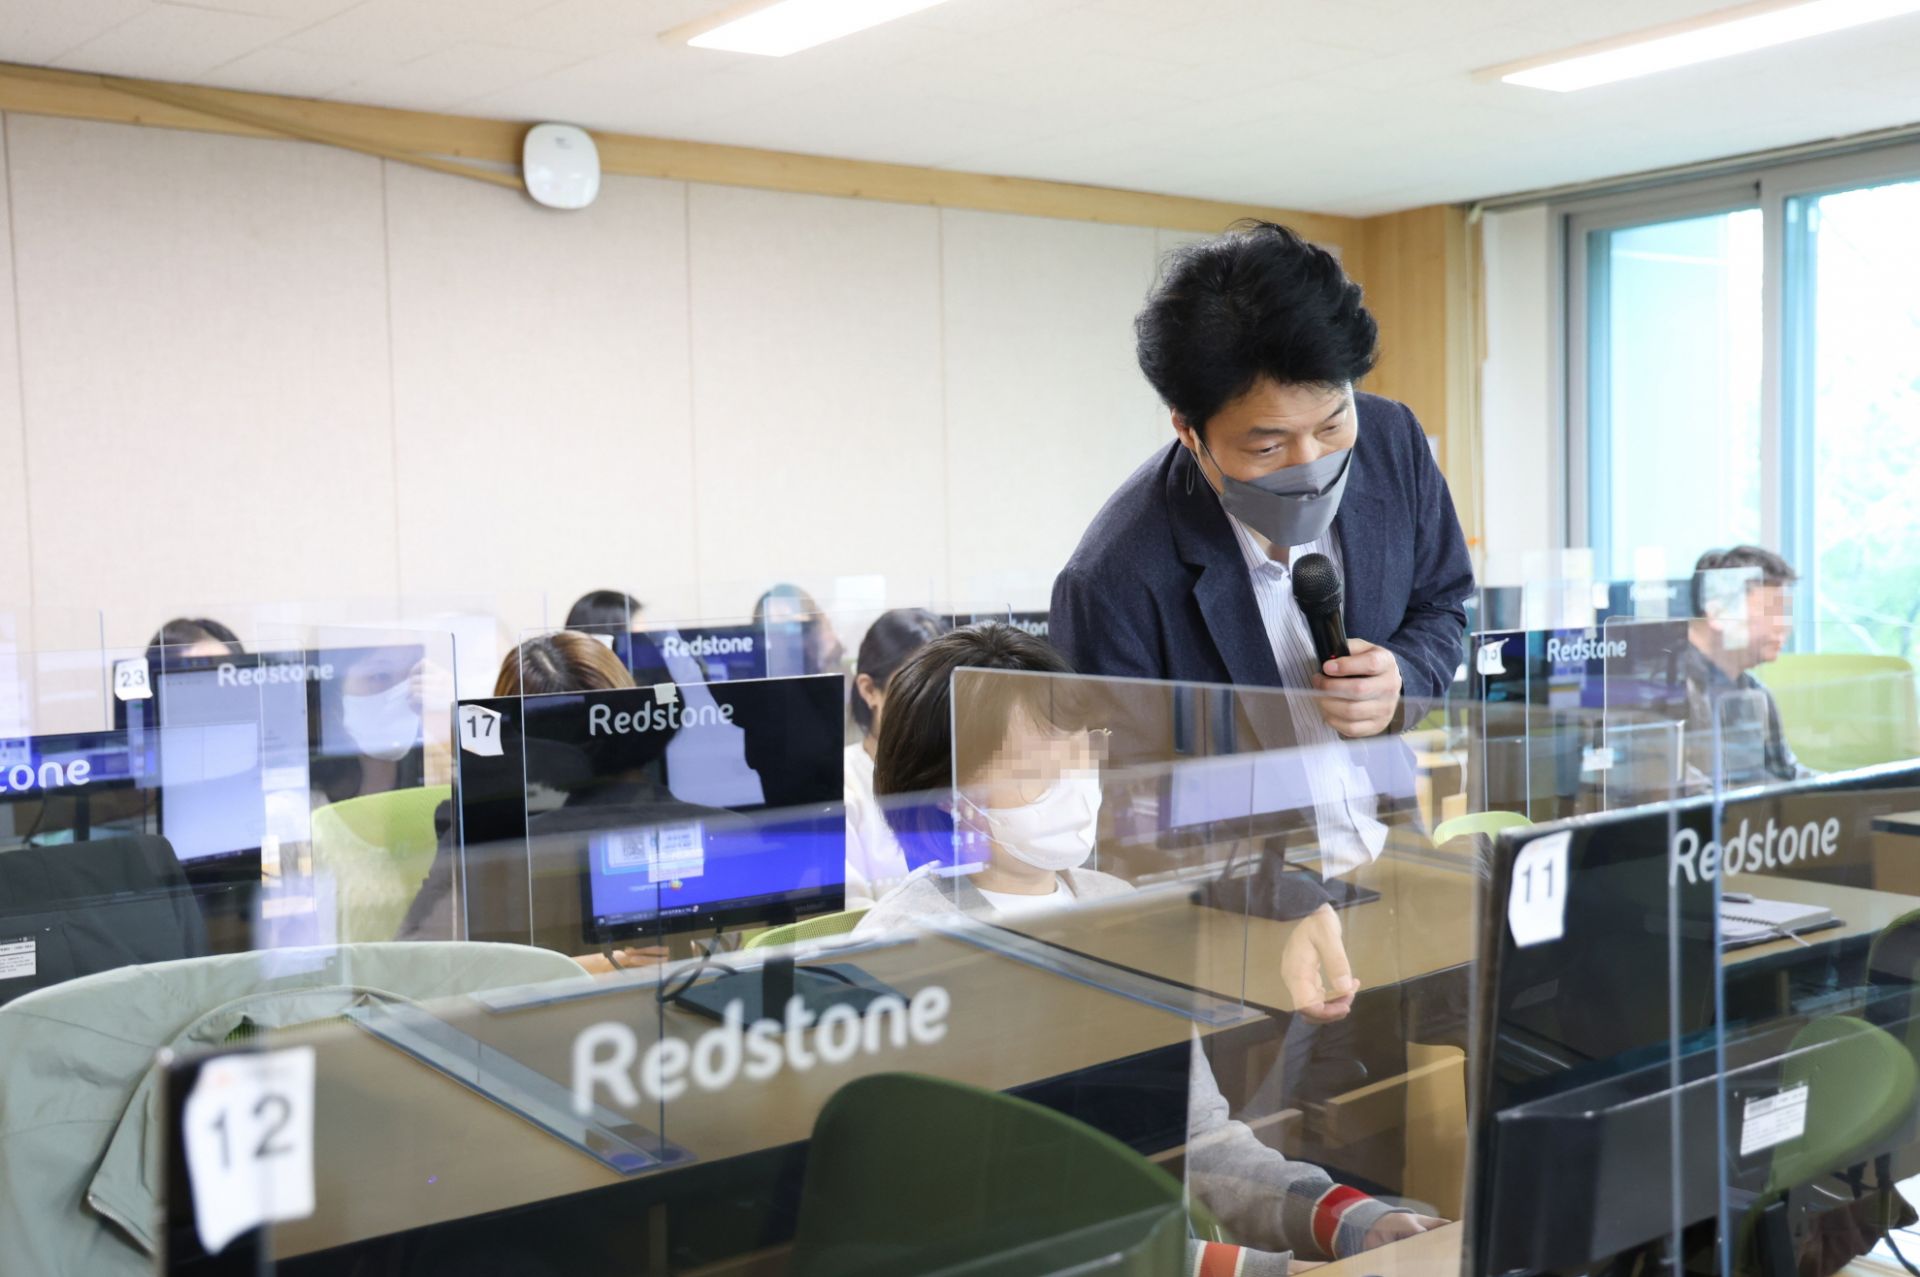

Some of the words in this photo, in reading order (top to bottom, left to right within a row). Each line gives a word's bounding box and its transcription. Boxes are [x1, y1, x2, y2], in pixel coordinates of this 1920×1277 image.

[663, 635, 754, 658] Redstone
[1547, 637, 1628, 663] Redstone
[120, 669, 146, 689] 23
[217, 660, 335, 688] Redstone
[466, 713, 497, 738] 17
[589, 699, 735, 736] Redstone
[0, 759, 91, 793] one
[1669, 816, 1841, 888] Redstone
[1519, 853, 1554, 905] 11
[570, 985, 952, 1117] Redstone
[209, 1092, 295, 1172] 12
